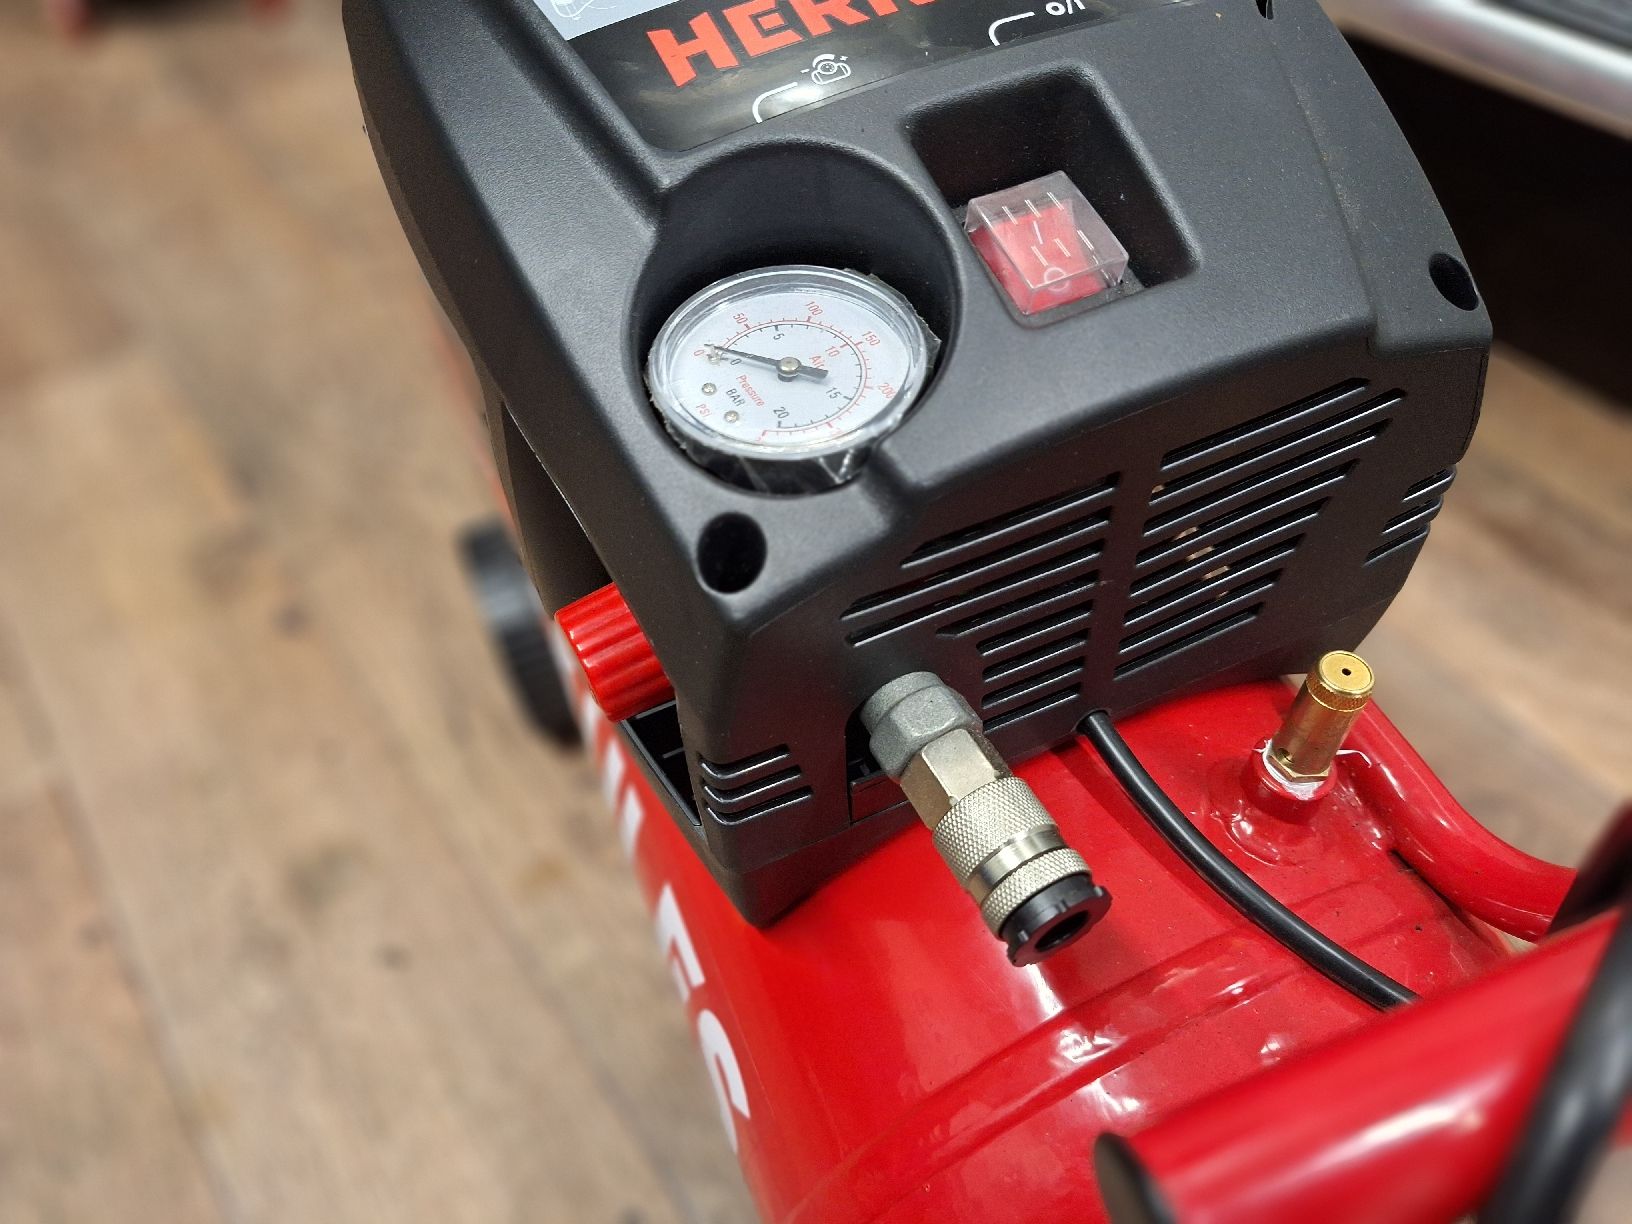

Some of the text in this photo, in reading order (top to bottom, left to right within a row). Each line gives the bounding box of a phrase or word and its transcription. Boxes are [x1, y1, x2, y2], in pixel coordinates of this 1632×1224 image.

[805, 301, 823, 316] 100
[733, 312, 748, 325] 50
[773, 333, 785, 341] 5
[861, 330, 881, 346] 150
[825, 345, 840, 358] 10
[726, 388, 746, 407] BAR
[736, 374, 765, 407] Pressure
[826, 387, 841, 399] 15
[696, 403, 713, 418] PSI
[773, 406, 790, 419] 20
